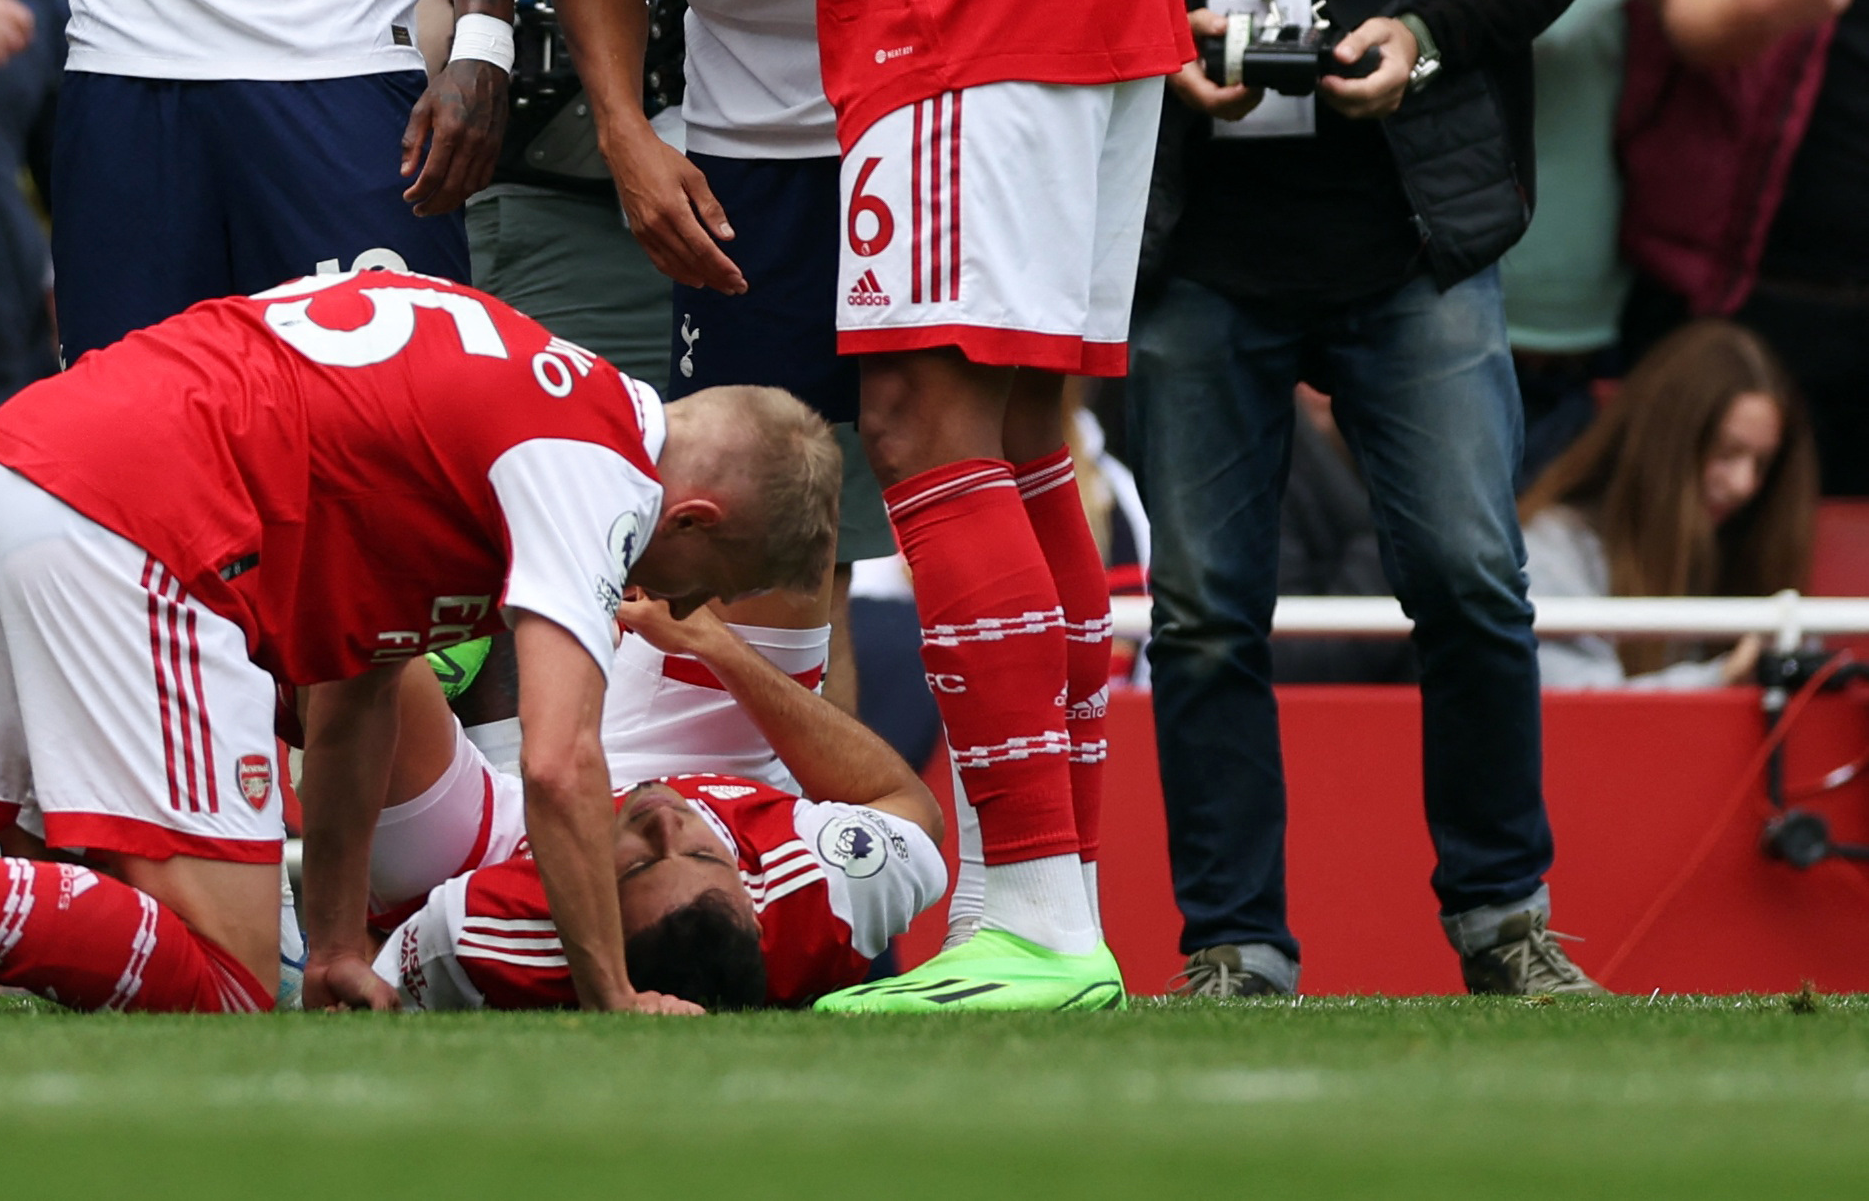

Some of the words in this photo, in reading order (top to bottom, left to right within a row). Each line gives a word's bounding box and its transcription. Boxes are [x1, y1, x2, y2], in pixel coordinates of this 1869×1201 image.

[847, 156, 895, 258] 6
[848, 292, 891, 306] adidas
[531, 335, 598, 398] KO
